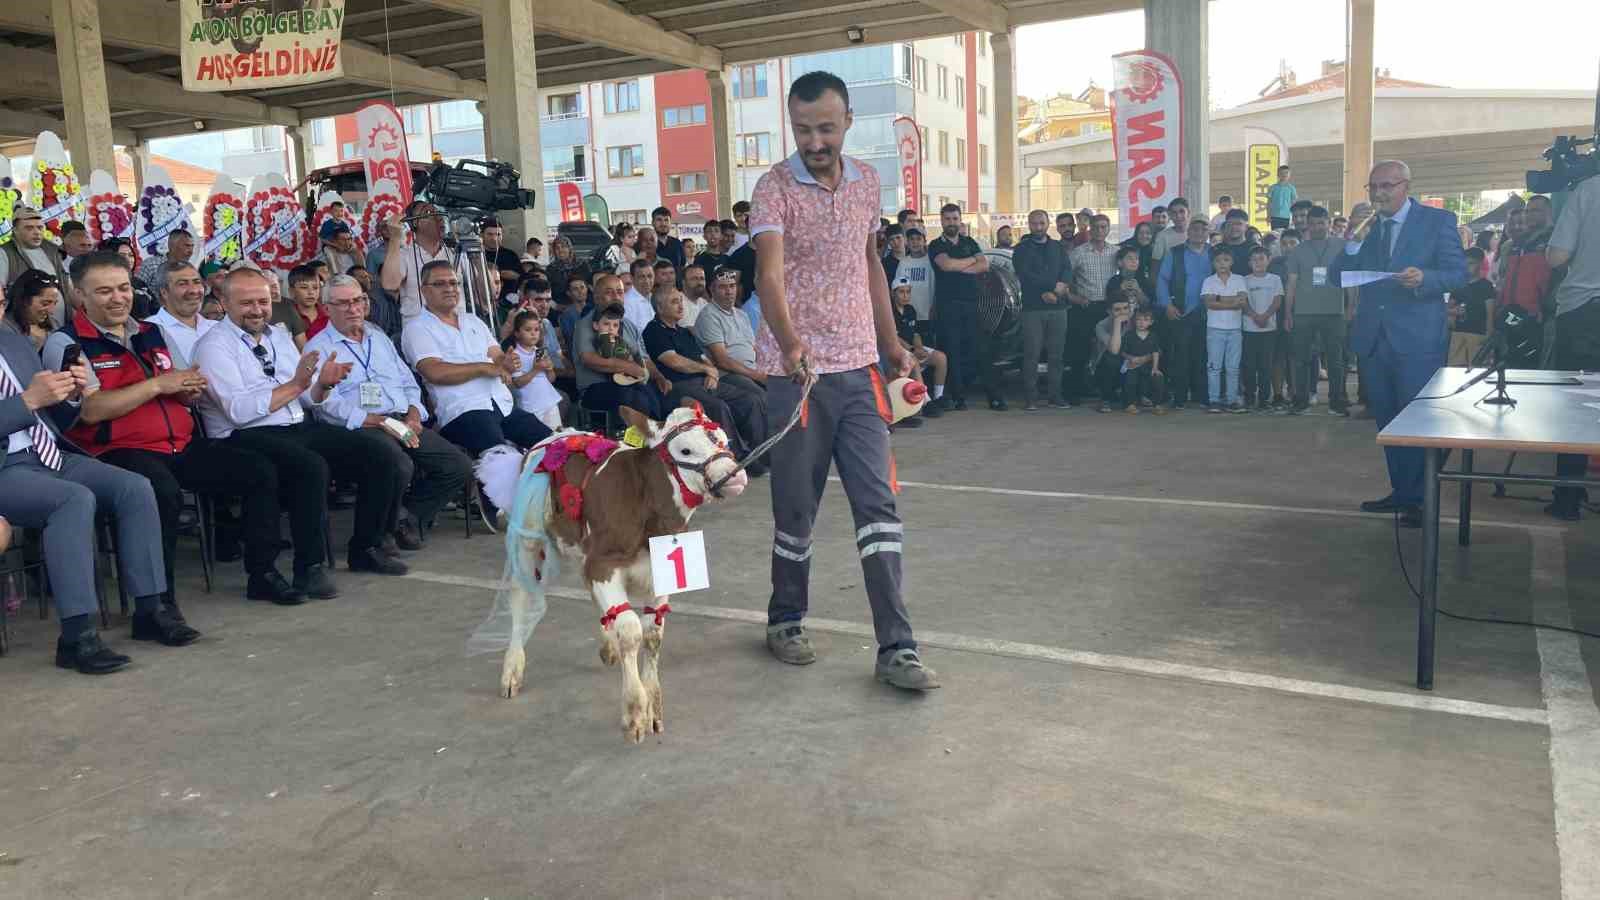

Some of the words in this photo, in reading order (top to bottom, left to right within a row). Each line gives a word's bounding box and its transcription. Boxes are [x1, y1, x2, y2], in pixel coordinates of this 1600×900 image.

[241, 10, 298, 38] BÖLGE
[304, 7, 344, 32] BAY
[196, 40, 339, 86] HOŞGELDİNİZ
[667, 547, 687, 588] 1
